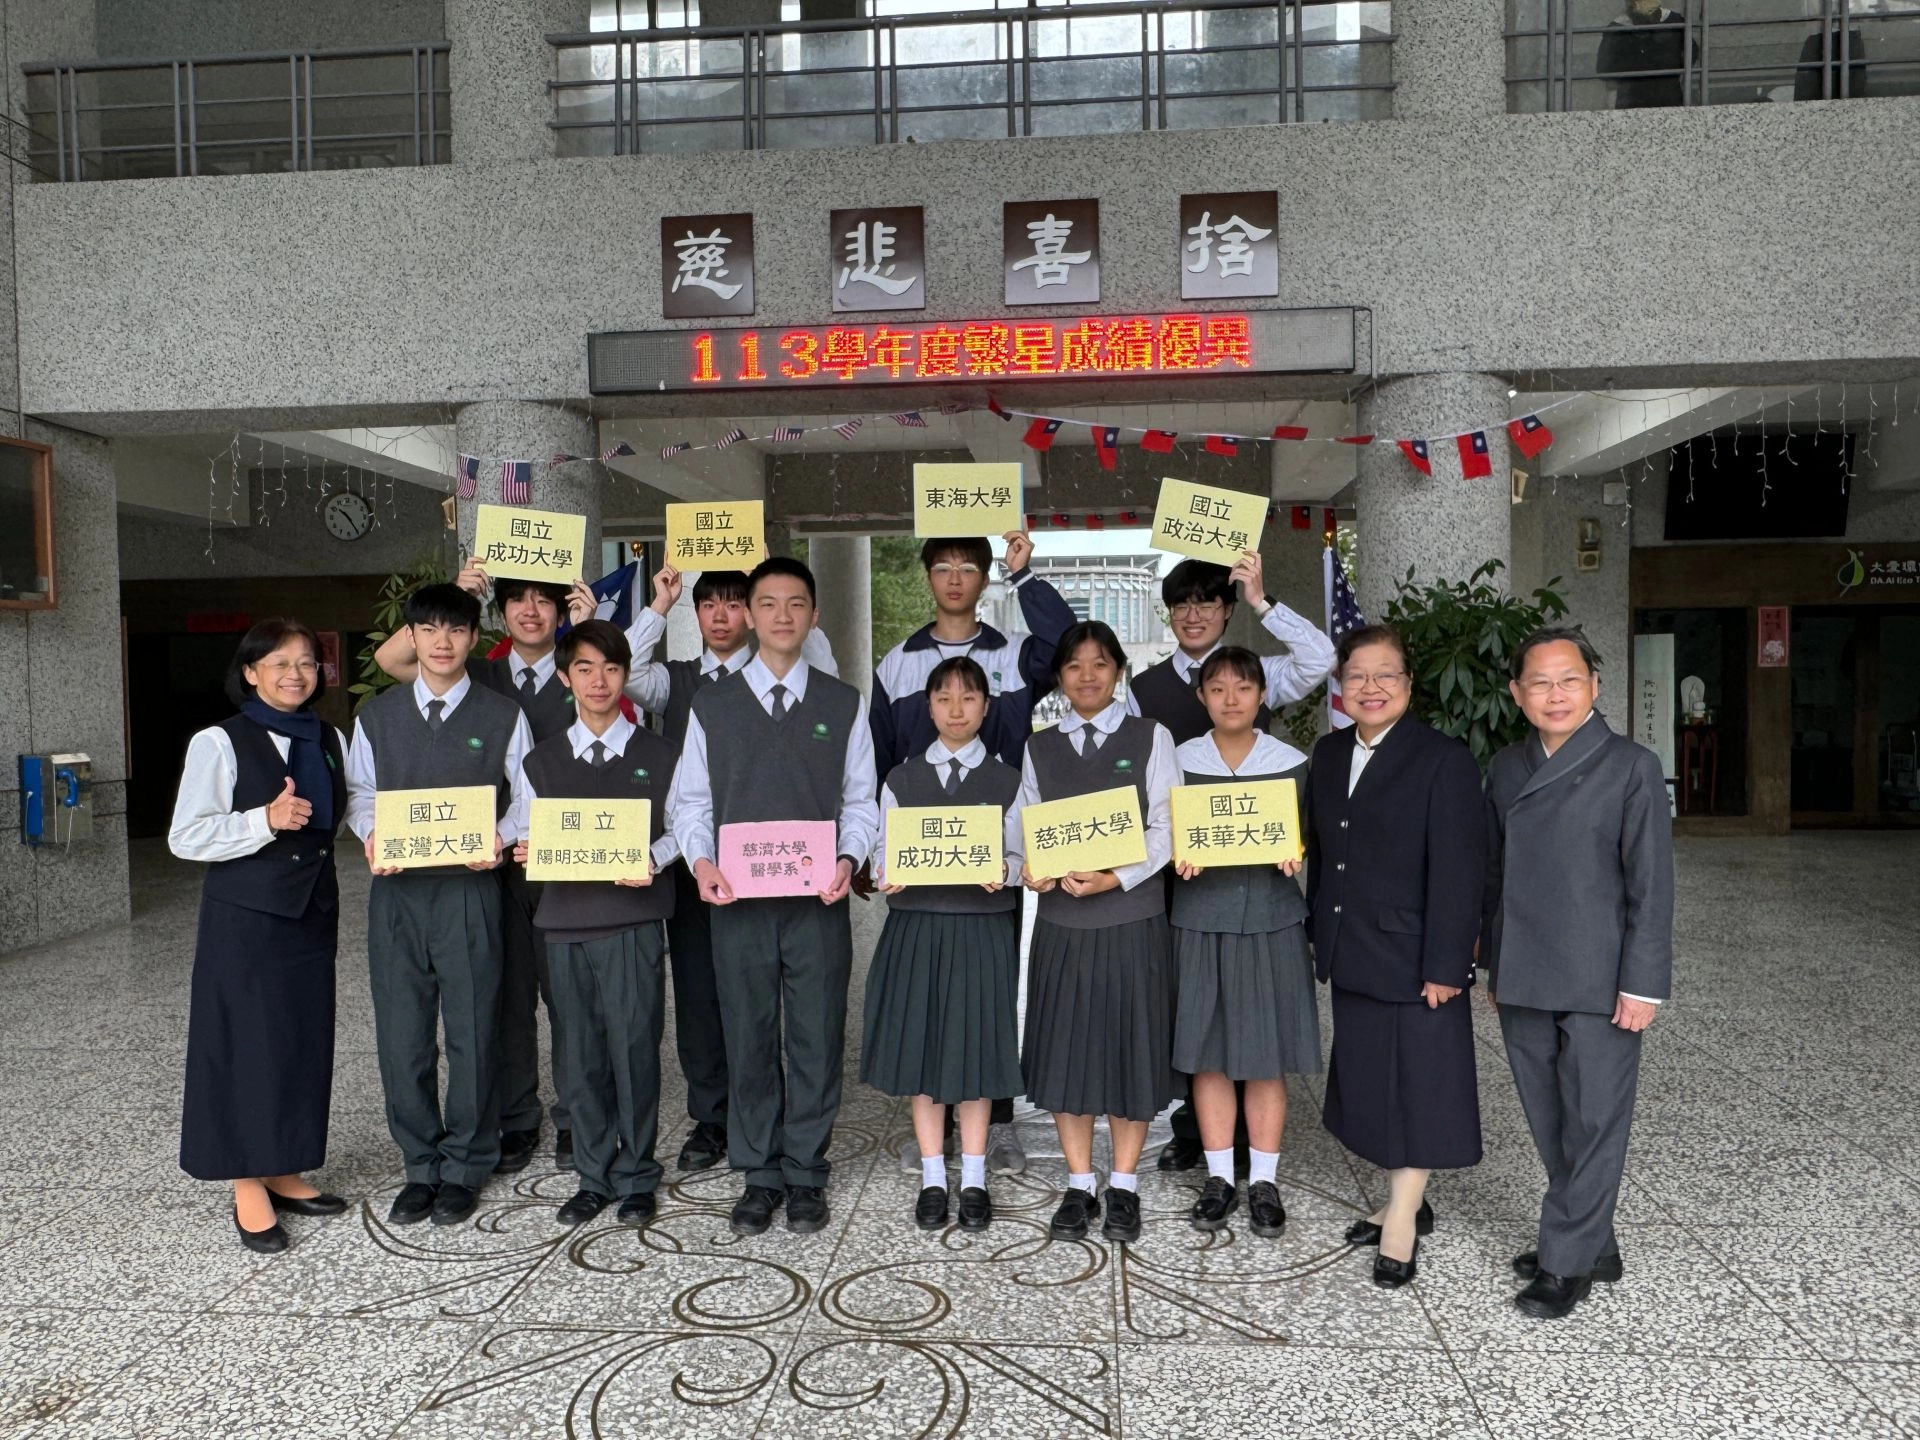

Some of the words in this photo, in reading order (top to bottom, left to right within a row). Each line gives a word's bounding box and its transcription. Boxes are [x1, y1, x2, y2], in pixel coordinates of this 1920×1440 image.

[925, 486, 1012, 509] 東海大學
[1189, 494, 1233, 521] 國立
[510, 518, 553, 541] 國立
[696, 510, 734, 531] 國立
[1161, 516, 1249, 552] 政治大學
[485, 541, 573, 569] 成功大學
[676, 536, 755, 558] 清華大學
[410, 800, 458, 824] 國立
[1209, 792, 1259, 818] 國立
[561, 810, 616, 832] 國立
[921, 816, 968, 840] 國立
[1034, 811, 1133, 850] 慈濟大學
[383, 832, 484, 860] 臺灣大學
[1186, 822, 1287, 850] 東華大學
[536, 847, 643, 866] 陽明交通大學
[742, 840, 808, 857] 慈濟大學
[896, 844, 992, 869] 成功大學
[750, 861, 799, 878] 醫學系
